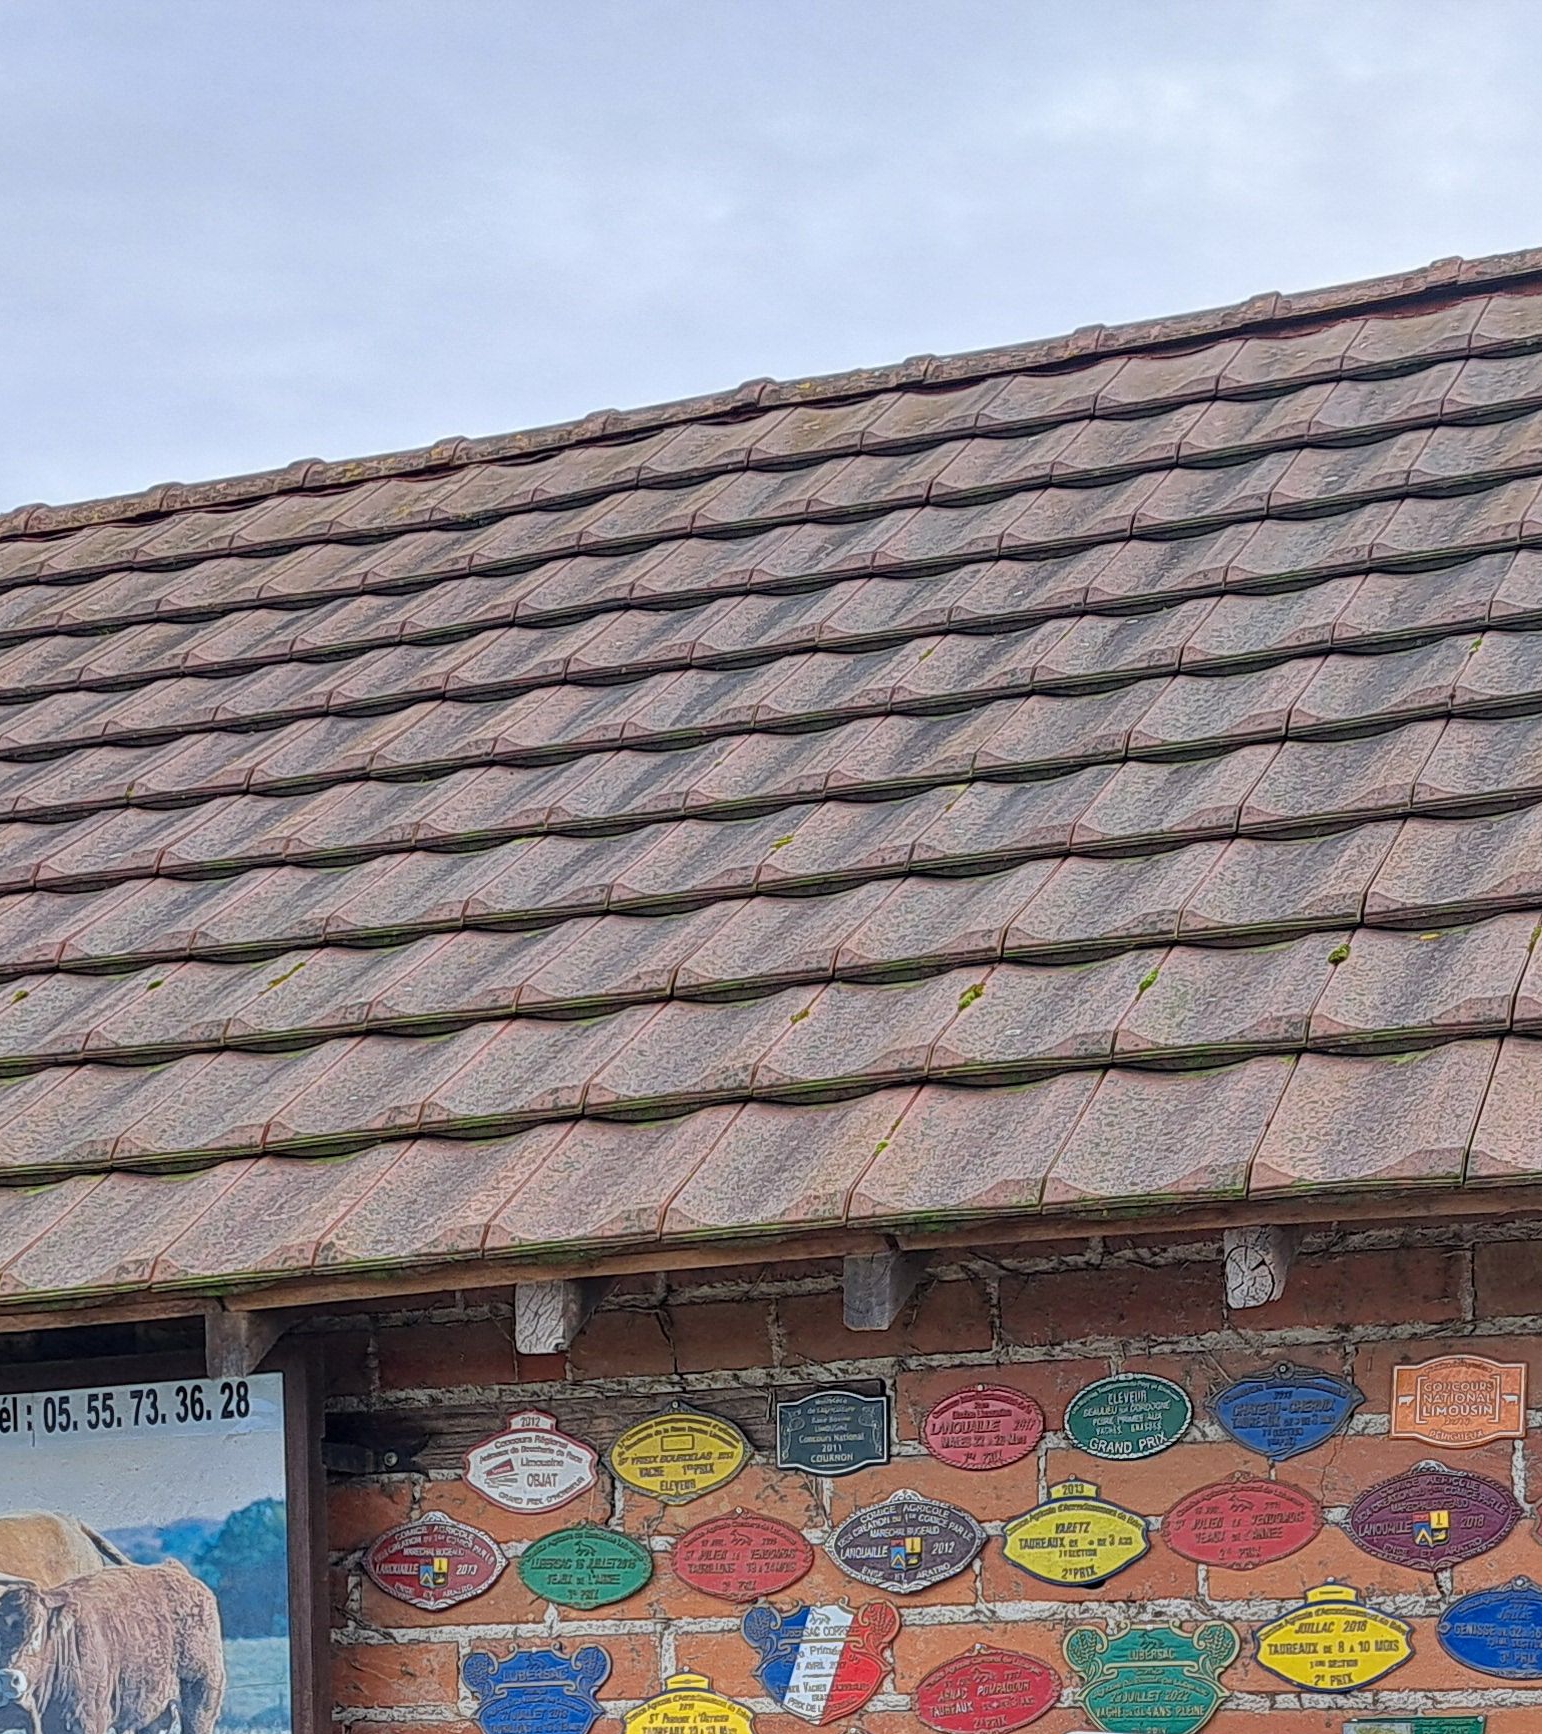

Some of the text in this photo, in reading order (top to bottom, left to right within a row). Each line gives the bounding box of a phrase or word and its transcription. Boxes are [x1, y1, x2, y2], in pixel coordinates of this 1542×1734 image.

[1423, 1381, 1493, 1392] CONCOURS
[220, 1381, 250, 1418] 28
[1108, 1390, 1147, 1404] ELEVEUR
[1423, 1393, 1491, 1403] NATIONAL
[1422, 1405, 1493, 1417] LIMOUSIN
[520, 1416, 540, 1427] 2012
[799, 1433, 865, 1443] Concours National
[1089, 1433, 1167, 1453] GRAND PRIX
[521, 1458, 564, 1467] Limousine
[810, 1453, 853, 1463] COURNON
[526, 1473, 559, 1487] OBJAT
[1062, 1484, 1084, 1495] 2013
[860, 1504, 950, 1523] COMICE AGRICOLE
[932, 1542, 955, 1555] 2012
[1018, 1537, 1065, 1549] TAUREAUX
[1294, 1621, 1335, 1634] JUILLAC
[1267, 1642, 1319, 1655] TAUREAUX
[1338, 1641, 1345, 1653] 8
[1358, 1641, 1370, 1652] 10
[1375, 1640, 1399, 1651] MOIS
[1128, 1650, 1176, 1660] LUBERSAC
[501, 1667, 568, 1681] LUBERSAC
[1330, 1673, 1354, 1686] PRIX
[1176, 1706, 1205, 1717] PLEINE
